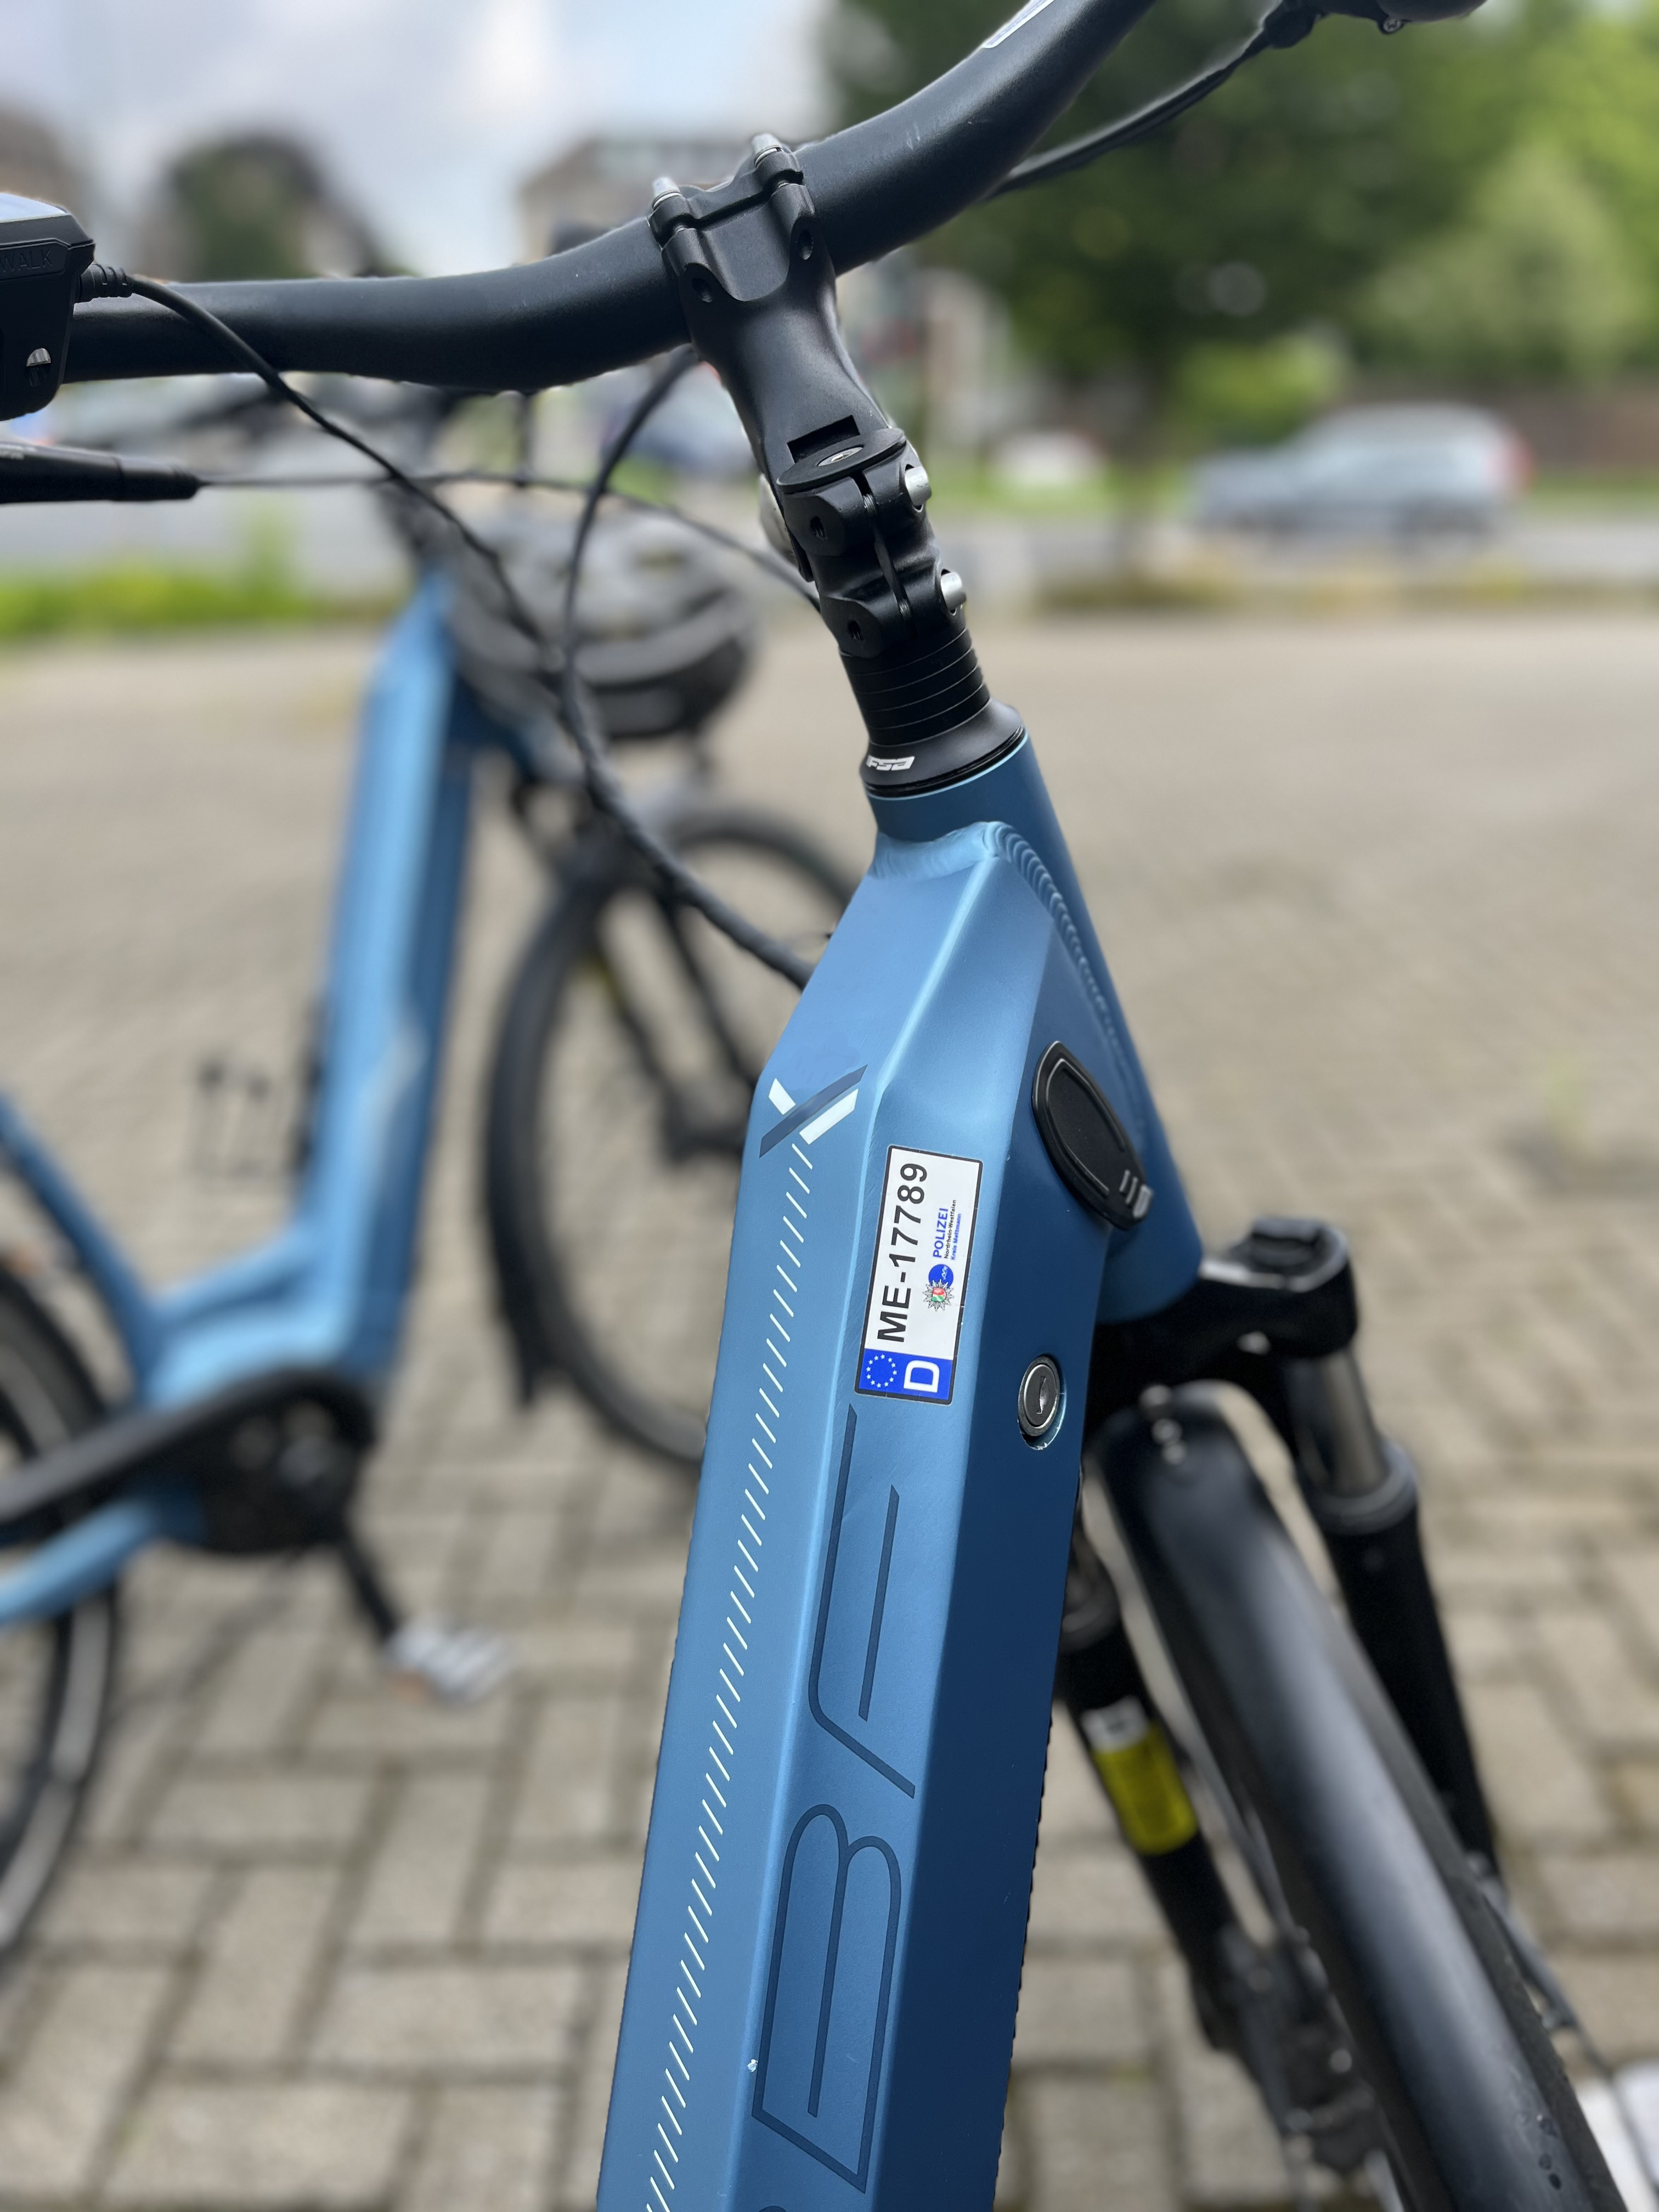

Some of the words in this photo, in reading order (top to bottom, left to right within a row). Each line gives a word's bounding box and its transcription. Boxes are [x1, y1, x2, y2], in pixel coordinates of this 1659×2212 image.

[0, 249, 53, 273] WALK
[877, 1163, 928, 1342] ME-17789
[933, 1208, 949, 1258] POLIZEI
[944, 1199, 957, 1259] Nordrhein-Westfalen
[903, 1360, 940, 1393] D
[752, 1403, 916, 2212] BF
